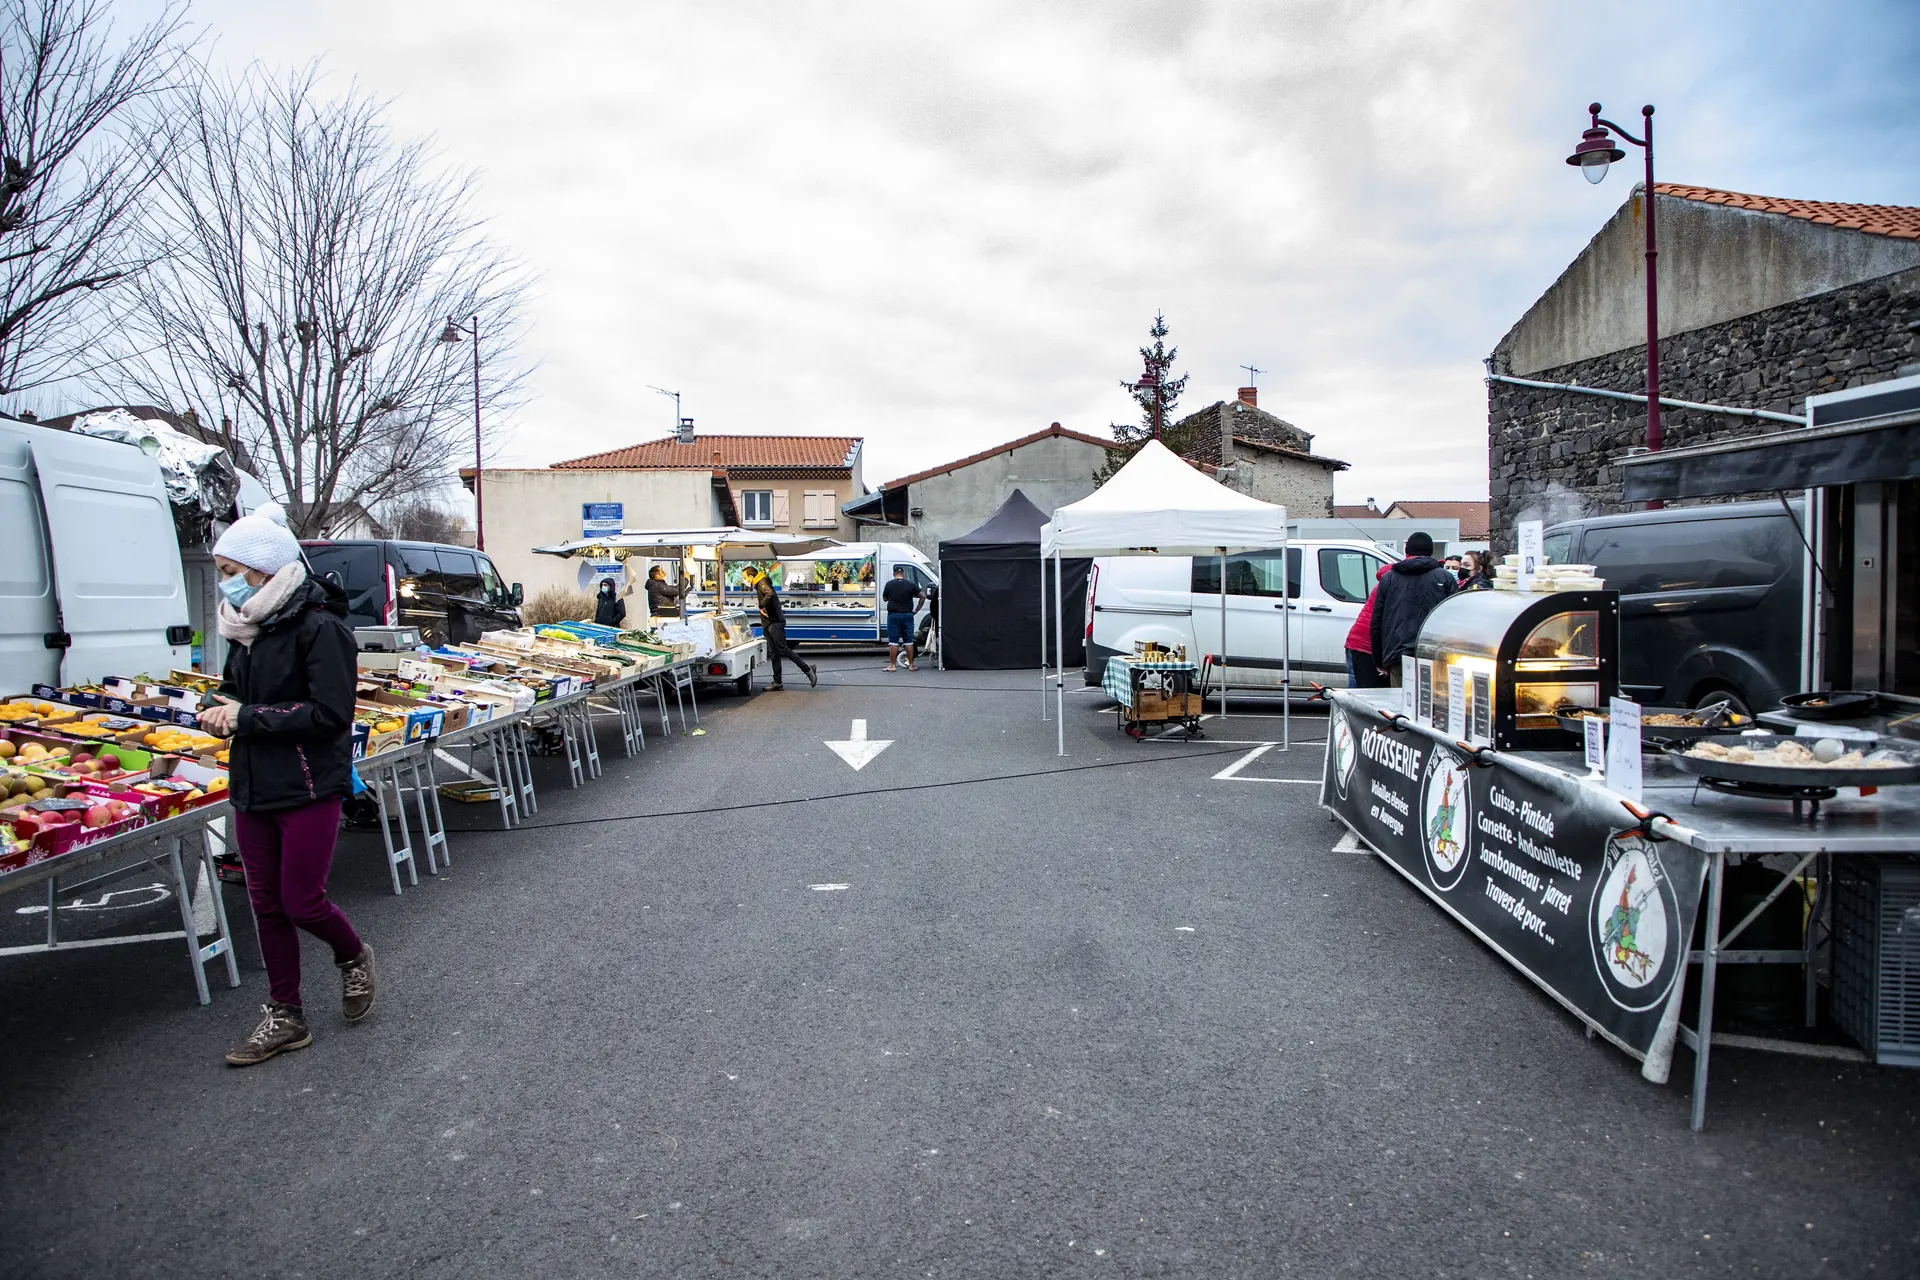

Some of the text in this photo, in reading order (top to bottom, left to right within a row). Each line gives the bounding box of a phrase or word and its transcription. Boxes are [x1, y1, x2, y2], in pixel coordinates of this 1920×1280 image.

[1361, 725, 1422, 782] RÔTISSERIE
[1370, 805, 1405, 836] en Auvergne
[1371, 778, 1409, 817] Volailles élevées
[1490, 785, 1516, 816] Cuisse
[1520, 800, 1555, 839] Pintade
[1478, 811, 1513, 845] Canette
[1518, 831, 1582, 881] Andouillette
[1479, 842, 1541, 893] Jambonneau
[1540, 878, 1572, 915] jarret
[1485, 876, 1516, 913] Travers
[1512, 897, 1523, 921] de
[1521, 909, 1546, 937] porc
